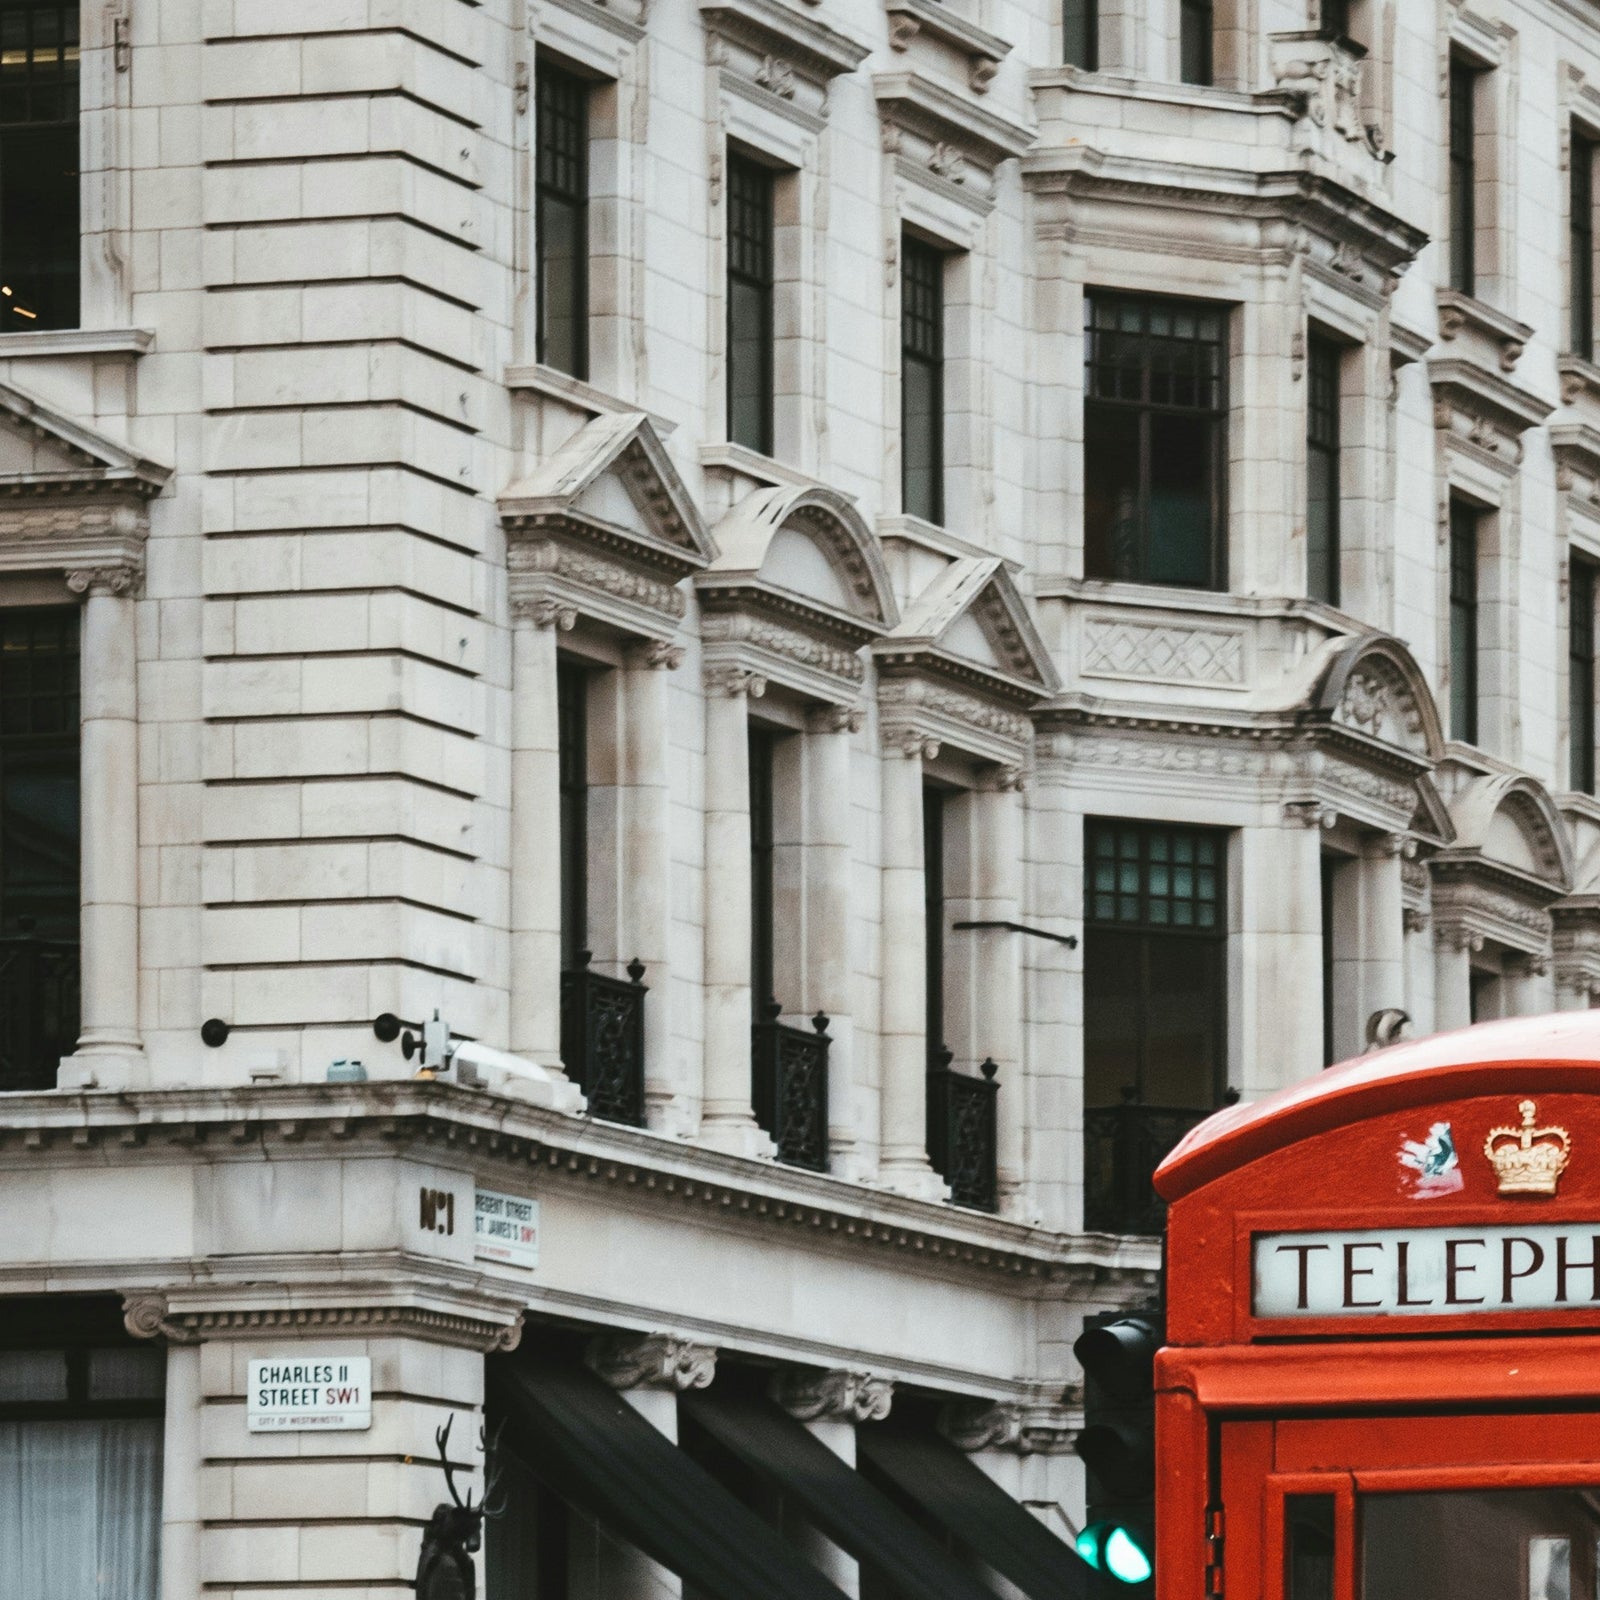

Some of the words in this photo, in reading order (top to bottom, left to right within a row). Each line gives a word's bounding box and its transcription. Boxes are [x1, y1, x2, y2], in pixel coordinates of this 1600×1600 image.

[259, 1366, 333, 1384] CHARLES
[339, 1365, 348, 1382] II
[259, 1388, 320, 1407] STREET
[326, 1387, 360, 1405] SW1
